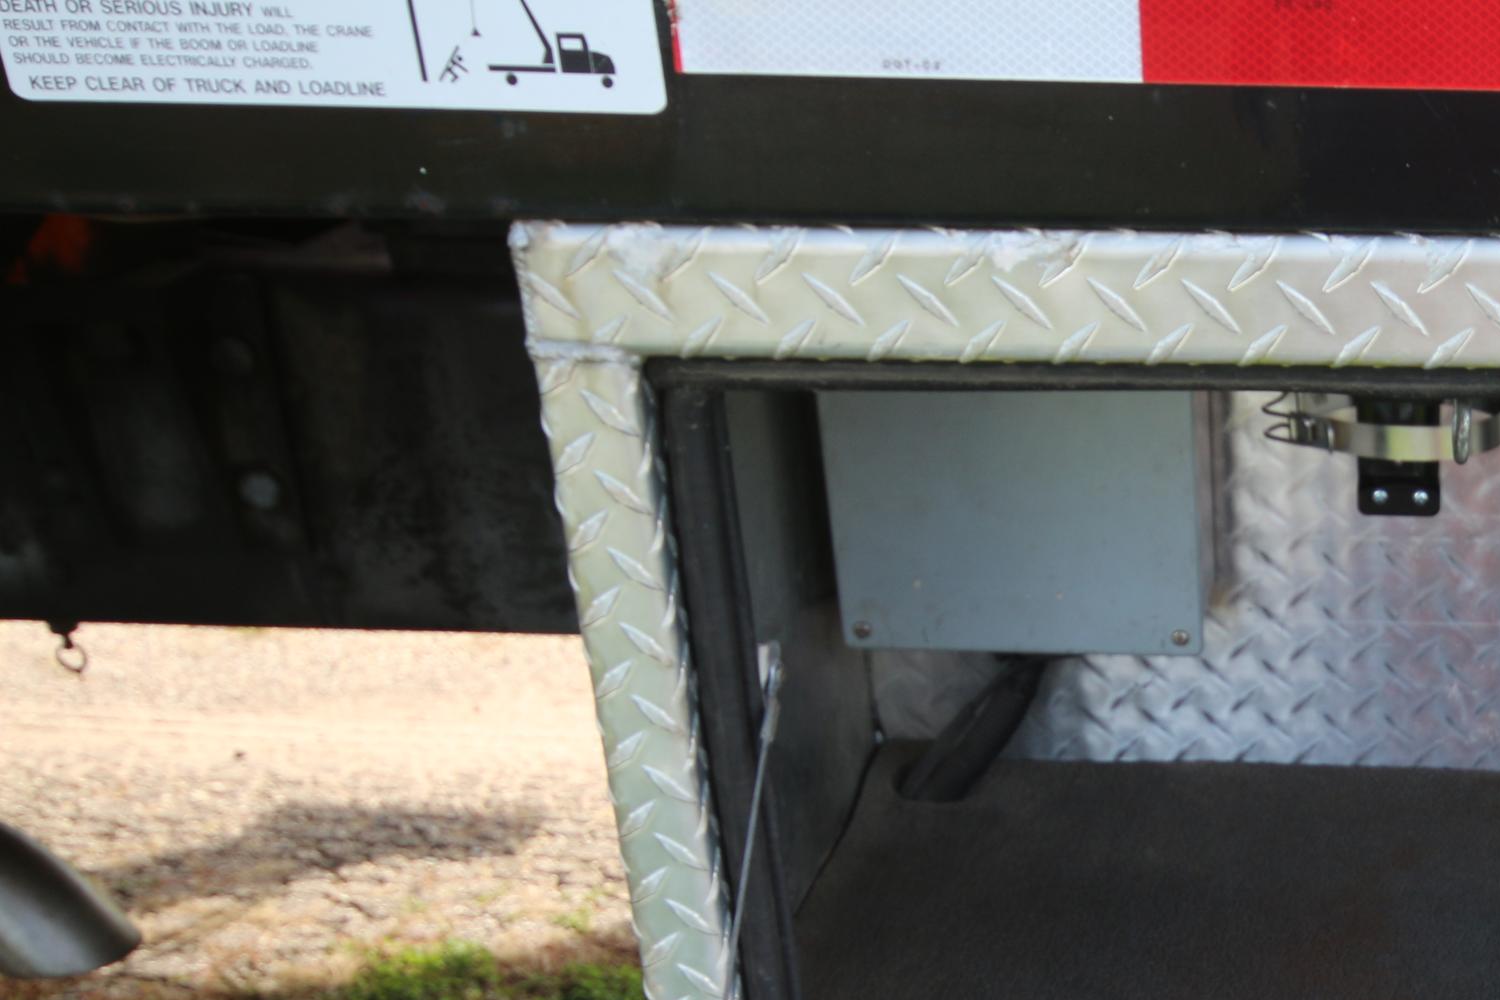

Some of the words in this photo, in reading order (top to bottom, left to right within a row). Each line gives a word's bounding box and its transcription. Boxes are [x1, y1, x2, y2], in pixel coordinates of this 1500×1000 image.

[0, 0, 57, 13] DEATH
[65, 0, 93, 14] OR
[102, 0, 182, 16] SERIOUS
[191, 1, 252, 17] INJURY
[260, 5, 294, 18] WILL
[3, 18, 54, 31] RESULT
[60, 19, 101, 32] FROM
[106, 20, 170, 34] CONTACT
[177, 22, 210, 34] WITH
[216, 22, 242, 34] THE
[293, 24, 321, 36] THE
[326, 25, 375, 38] CRANE
[8, 35, 30, 48] OR
[33, 36, 62, 48] THE
[67, 36, 124, 49] VEHICLE
[129, 38, 141, 49] IF
[147, 38, 174, 50] THE
[180, 39, 222, 51] BOOM
[227, 40, 247, 52] OR
[252, 40, 320, 53] LOADLINE
[12, 52, 70, 65] SHOULD
[75, 54, 135, 66] BECOME
[140, 55, 236, 68] ELECTRICALLY
[242, 56, 313, 69] CHARGED.
[28, 75, 77, 91] KEEP
[85, 76, 145, 92] CLEAR
[152, 77, 177, 93] OF
[183, 78, 247, 94] TRUCK
[254, 80, 291, 95] AND
[298, 81, 387, 97] LOADLINE
